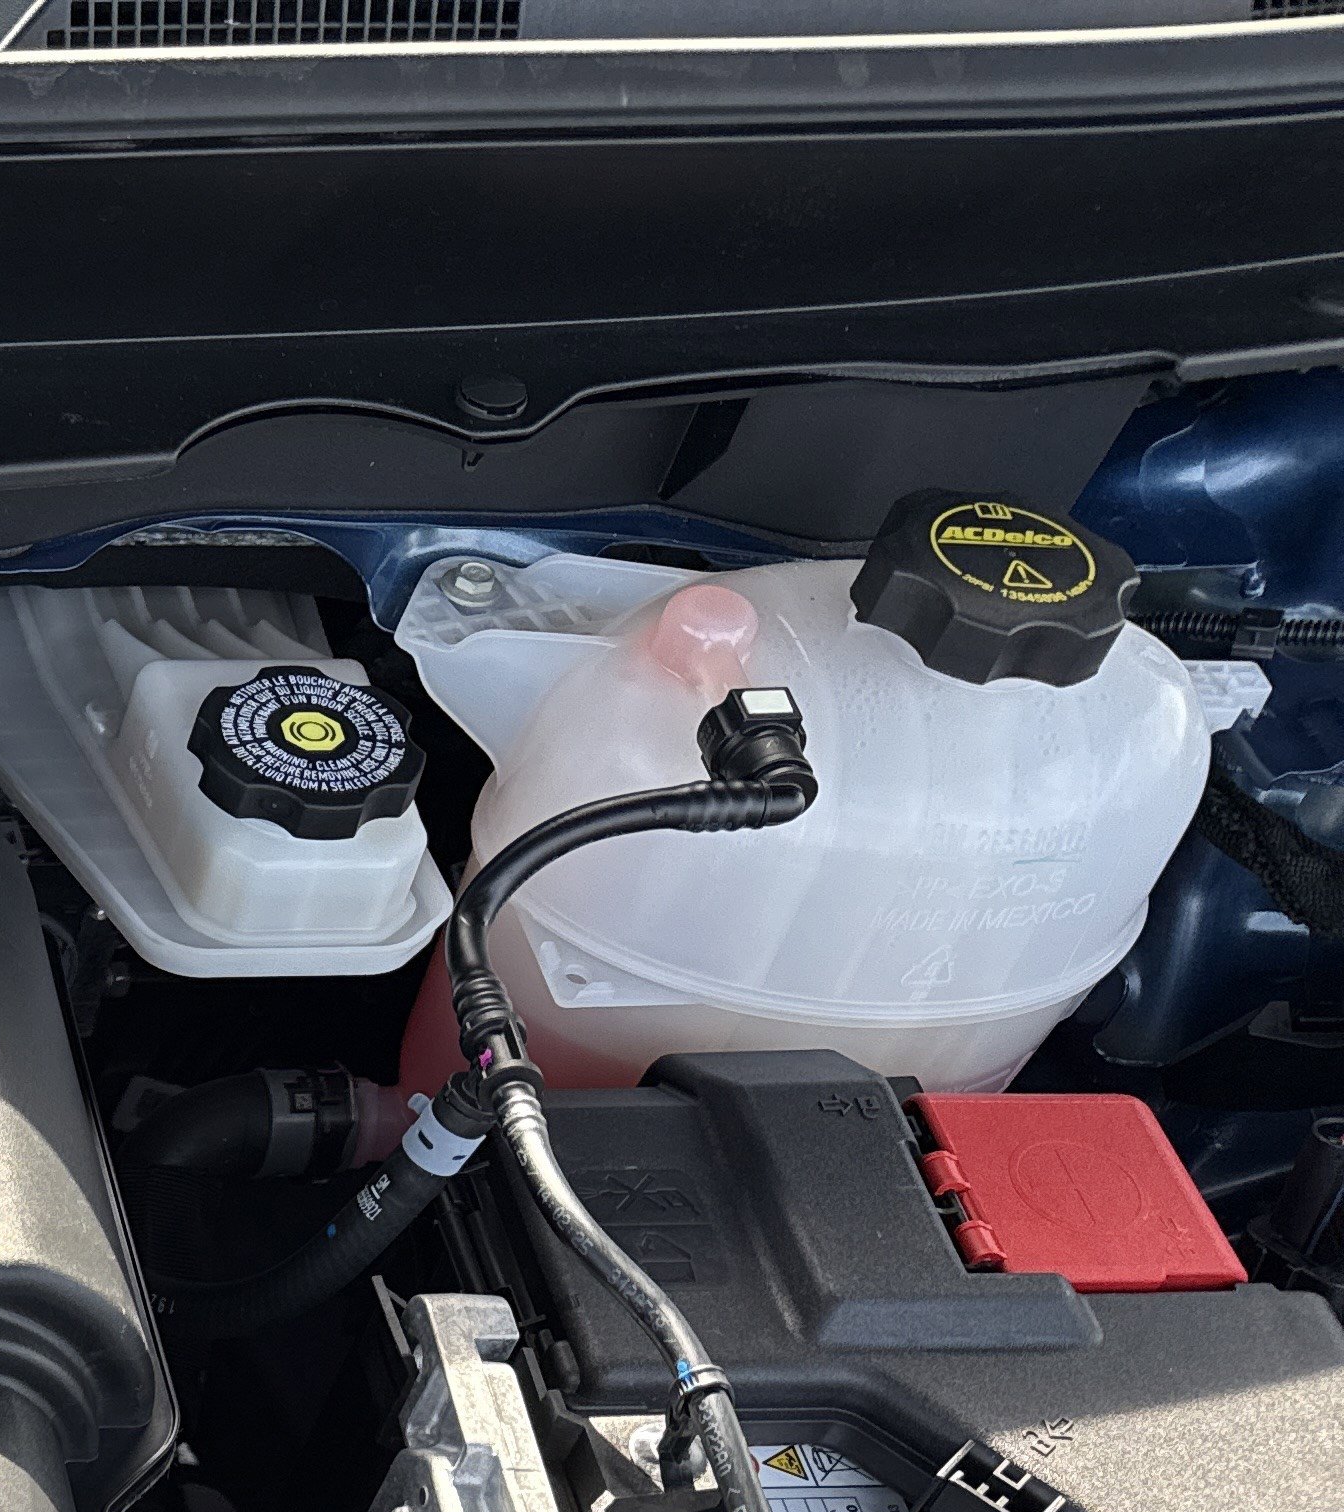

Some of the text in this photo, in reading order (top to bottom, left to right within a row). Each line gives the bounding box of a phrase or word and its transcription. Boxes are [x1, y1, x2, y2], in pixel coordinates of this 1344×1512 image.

[940, 526, 1073, 546] ACDelco
[272, 676, 286, 685] LE
[288, 675, 341, 691] BOUCHON
[341, 686, 377, 704] AVANT
[372, 703, 388, 715] LA
[275, 686, 290, 695] DU
[293, 685, 335, 698] LIQUIDE
[336, 694, 352, 705] DE
[280, 695, 345, 712] D'UN BIDON
[246, 742, 266, 756] CAP
[261, 755, 303, 777] BEFORE
[358, 758, 379, 773] USE
[316, 757, 352, 771] CLEAN
[253, 762, 285, 782] FLUID
[285, 776, 318, 791] FROM
[321, 782, 328, 792] A
[330, 776, 371, 791] SEALED
[977, 893, 1096, 931] MEXICO
